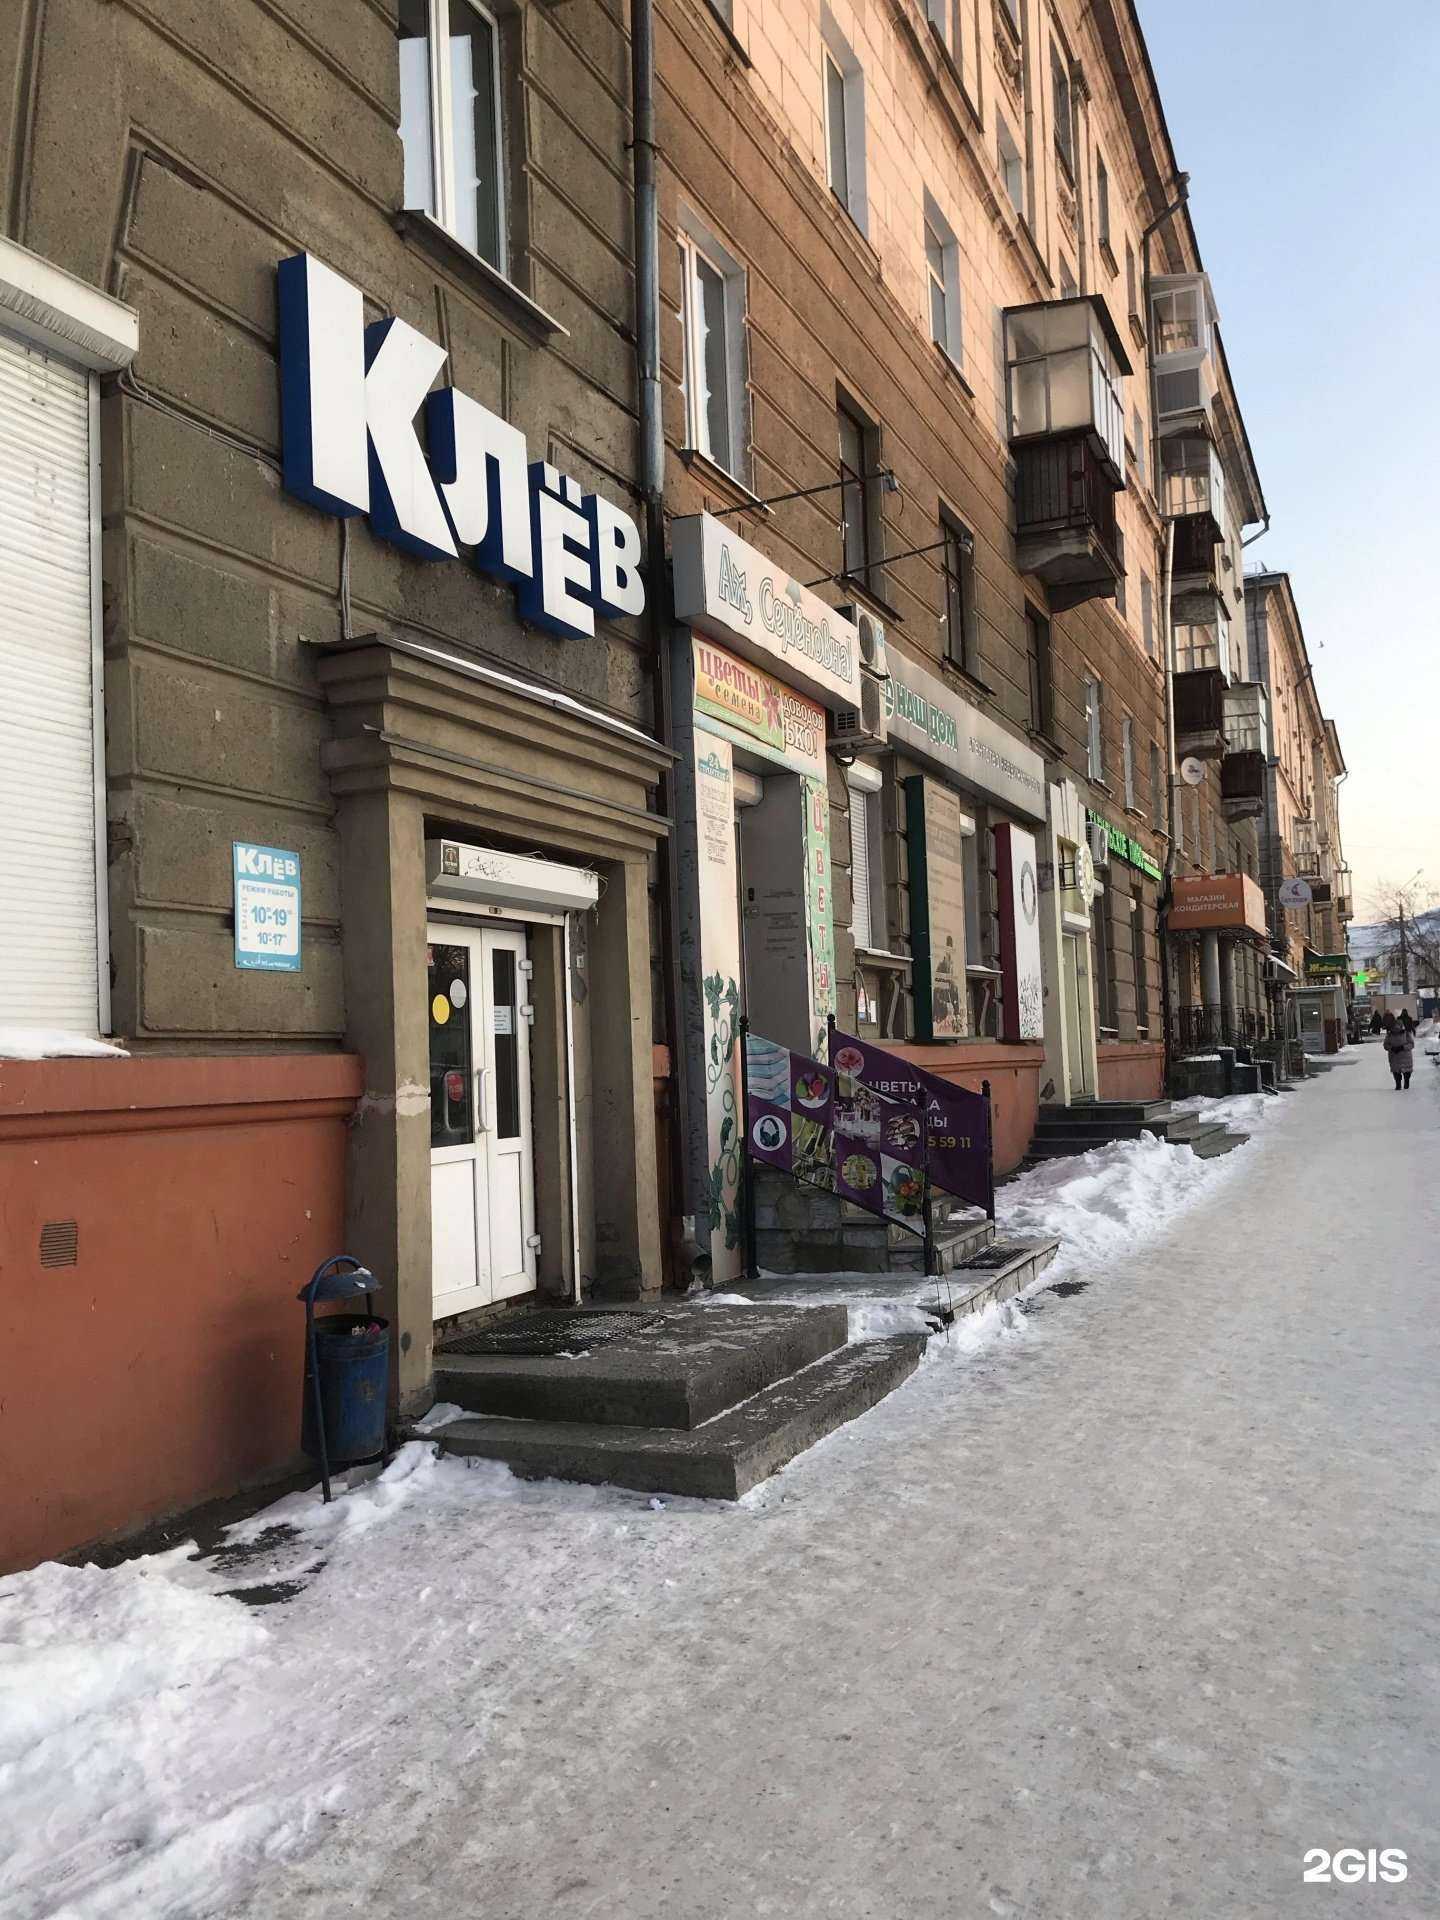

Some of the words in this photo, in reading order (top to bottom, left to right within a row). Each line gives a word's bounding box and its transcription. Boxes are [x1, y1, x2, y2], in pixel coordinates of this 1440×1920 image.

[305, 252, 646, 638] КЛЁВ
[895, 681, 928, 734] НАШ
[928, 704, 958, 752] ДОМ
[237, 846, 297, 880] КЛЁВ
[940, 1136, 956, 1148] 59
